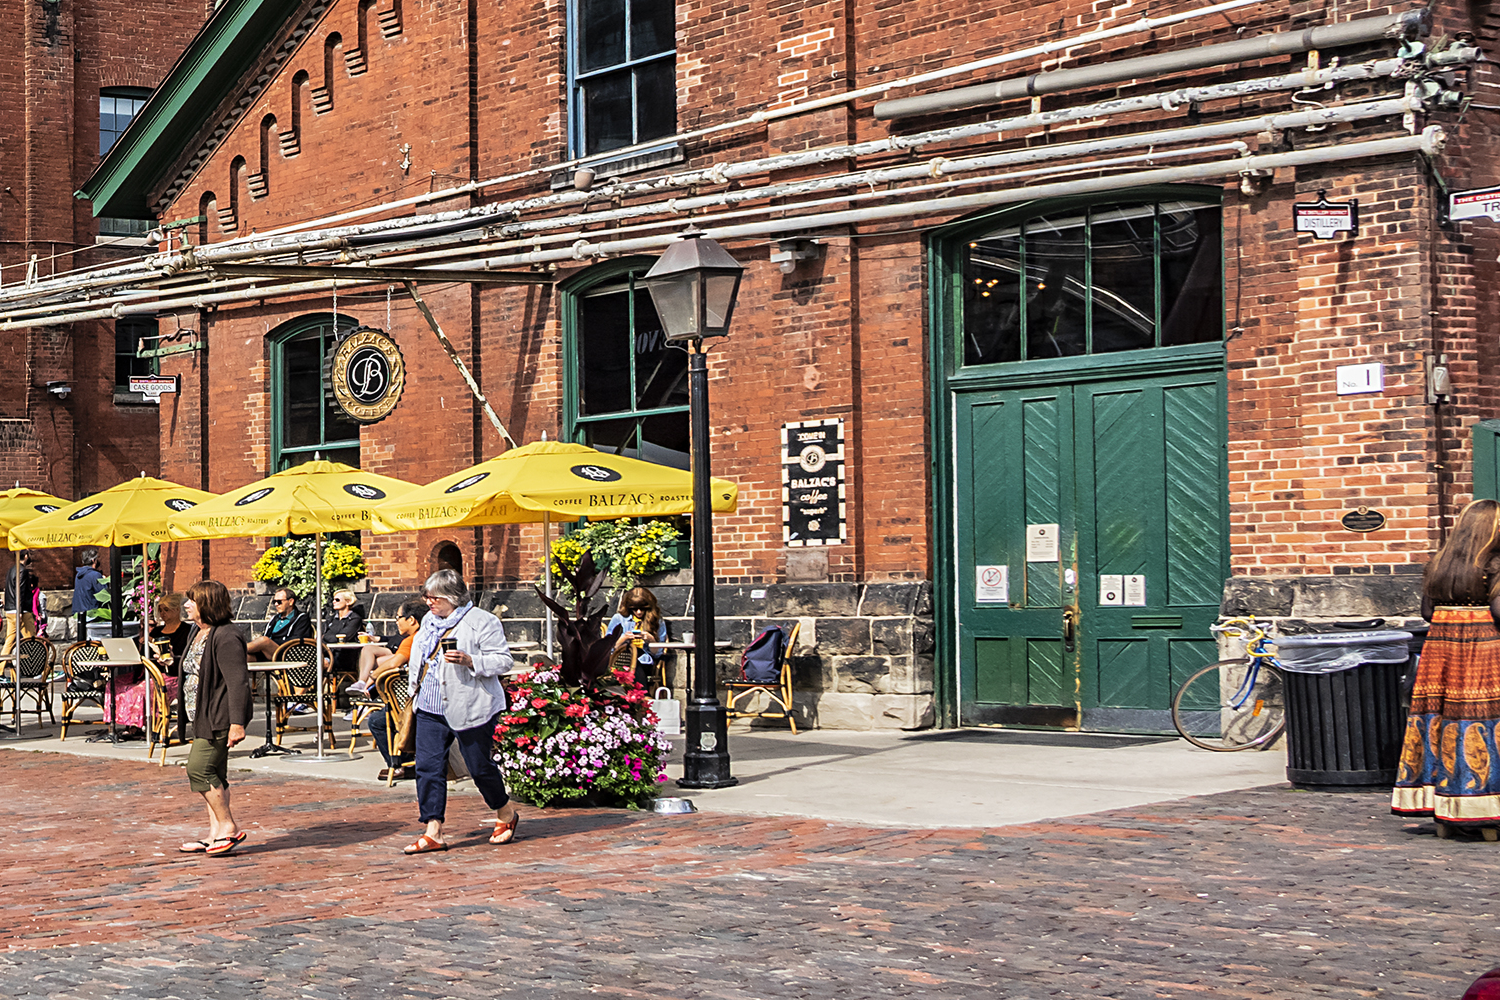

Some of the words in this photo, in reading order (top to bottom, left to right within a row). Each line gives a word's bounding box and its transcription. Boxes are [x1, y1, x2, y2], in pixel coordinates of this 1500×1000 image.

[1304, 218, 1343, 228] DISTILLERY
[340, 333, 394, 359] BALZAC'S
[346, 400, 391, 417] COFFEE
[791, 477, 836, 489] BALZAC'S
[553, 498, 582, 506] COFFEE
[800, 490, 828, 505] coffee
